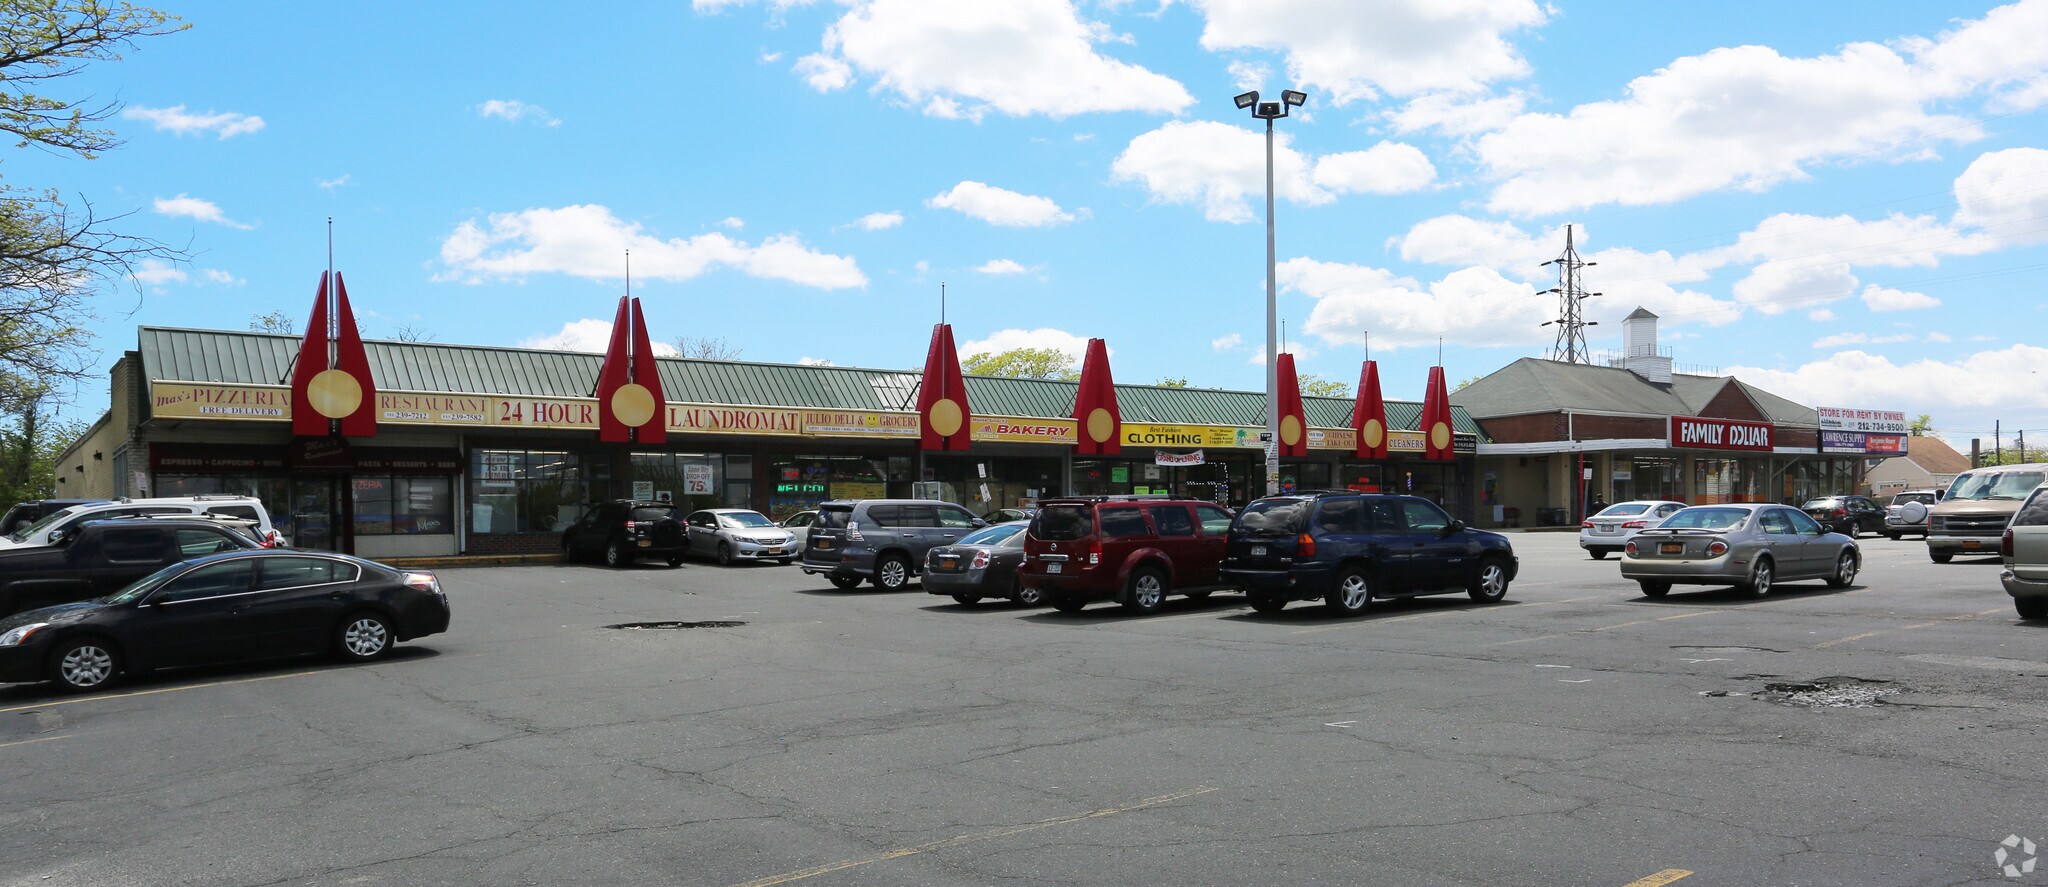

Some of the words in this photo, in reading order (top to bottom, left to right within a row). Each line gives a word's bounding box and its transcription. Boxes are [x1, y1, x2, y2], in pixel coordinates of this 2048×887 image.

[193, 389, 288, 406] PIZZERIA
[381, 396, 486, 412] RESTAURANT
[203, 406, 227, 414] FREE
[231, 407, 280, 415] DELIVERY
[500, 401, 522, 422] 24
[532, 402, 593, 424] HOUR
[1820, 408, 1840, 417] STORE
[1842, 410, 1854, 418] FOR
[1857, 411, 1872, 419] RENT
[1874, 412, 1881, 420] BY
[1883, 413, 1904, 421] OWNER
[670, 408, 799, 431] LAUNDROMAT
[805, 413, 831, 425] JULIO
[834, 414, 855, 425] DELI
[857, 415, 864, 425] &
[880, 415, 918, 427] GROCERY
[996, 424, 1070, 436] BAKERY
[1857, 422, 1904, 431] 212-734-9500
[1128, 433, 1201, 444] CLOTHING
[1328, 431, 1352, 439] CHINESE
[1681, 422, 1725, 445] FAMILY
[1729, 427, 1768, 446] DOLLAR
[1823, 432, 1848, 443] LAWRENCE
[1849, 434, 1865, 443] SUPPLY
[1327, 439, 1355, 447] TAKE-OUT
[1389, 438, 1424, 449] CLEANERS
[160, 458, 203, 467] ESPRESSO
